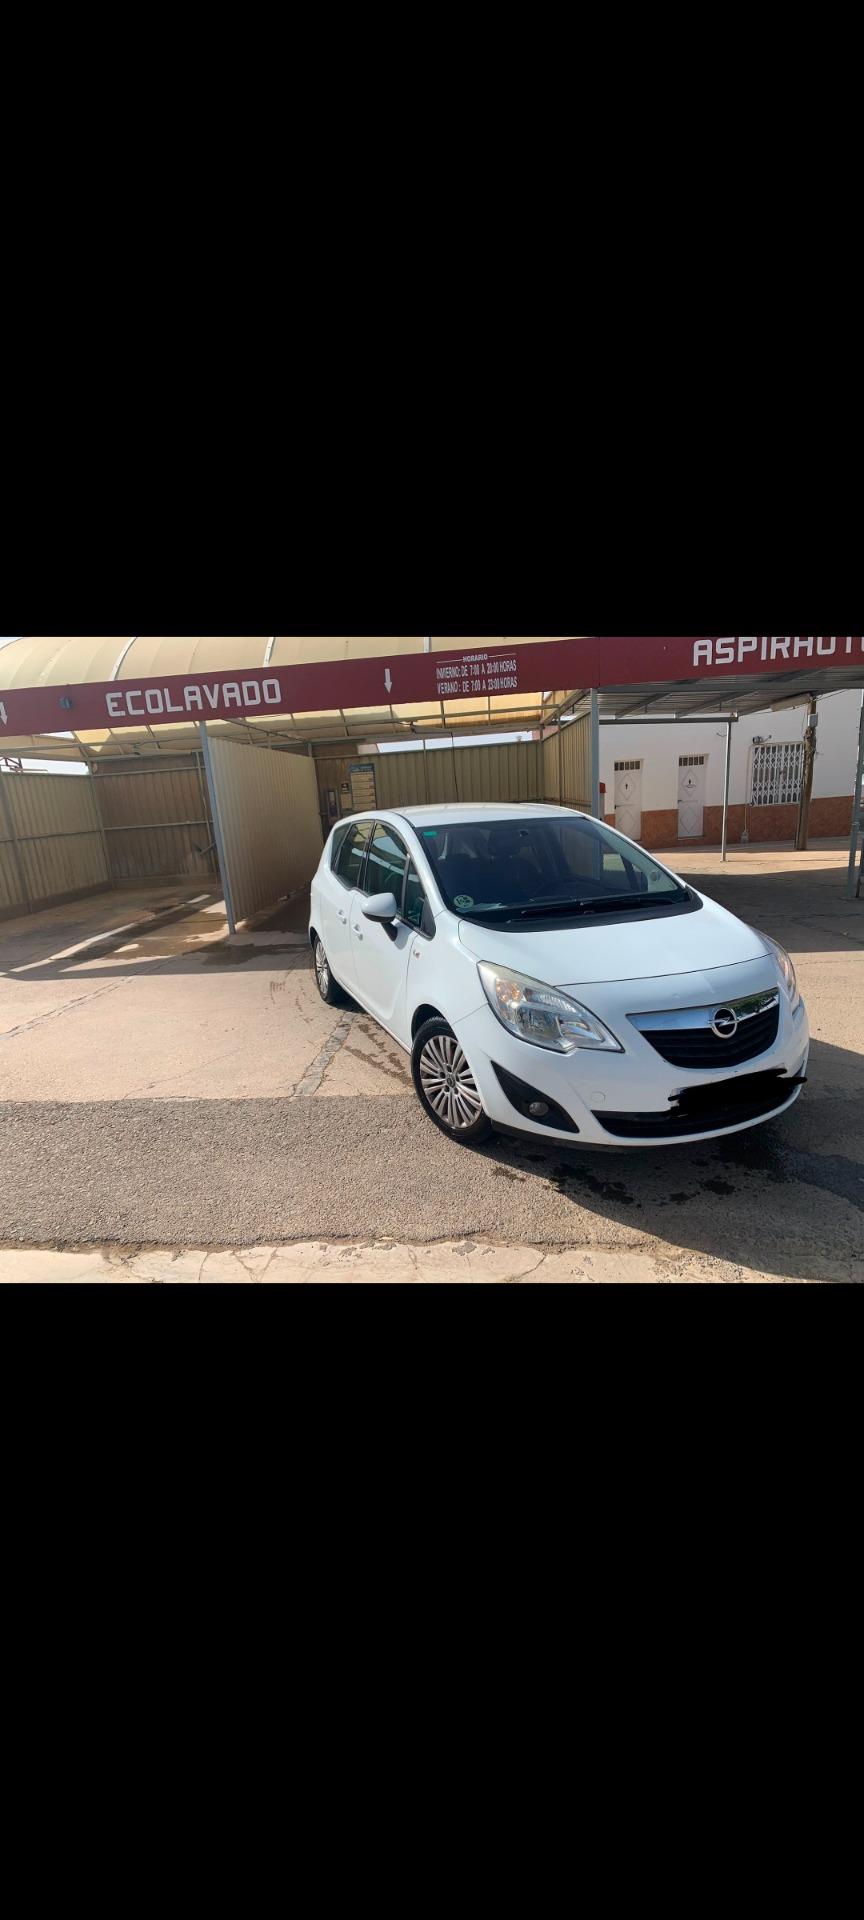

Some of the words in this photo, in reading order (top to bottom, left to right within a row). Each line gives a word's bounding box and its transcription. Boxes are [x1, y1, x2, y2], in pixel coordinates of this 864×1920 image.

[463, 654, 488, 662] HORARIO
[692, 636, 864, 667] ASPIRAUT
[462, 665, 468, 676] DE
[470, 664, 479, 675] 7:00
[482, 663, 486, 674] A
[500, 660, 516, 672] HORAS
[463, 681, 469, 692] DE
[471, 680, 480, 691] 7:00
[482, 679, 486, 690] A
[500, 676, 517, 688] HORAS
[105, 678, 282, 717] ECOLAVADO
